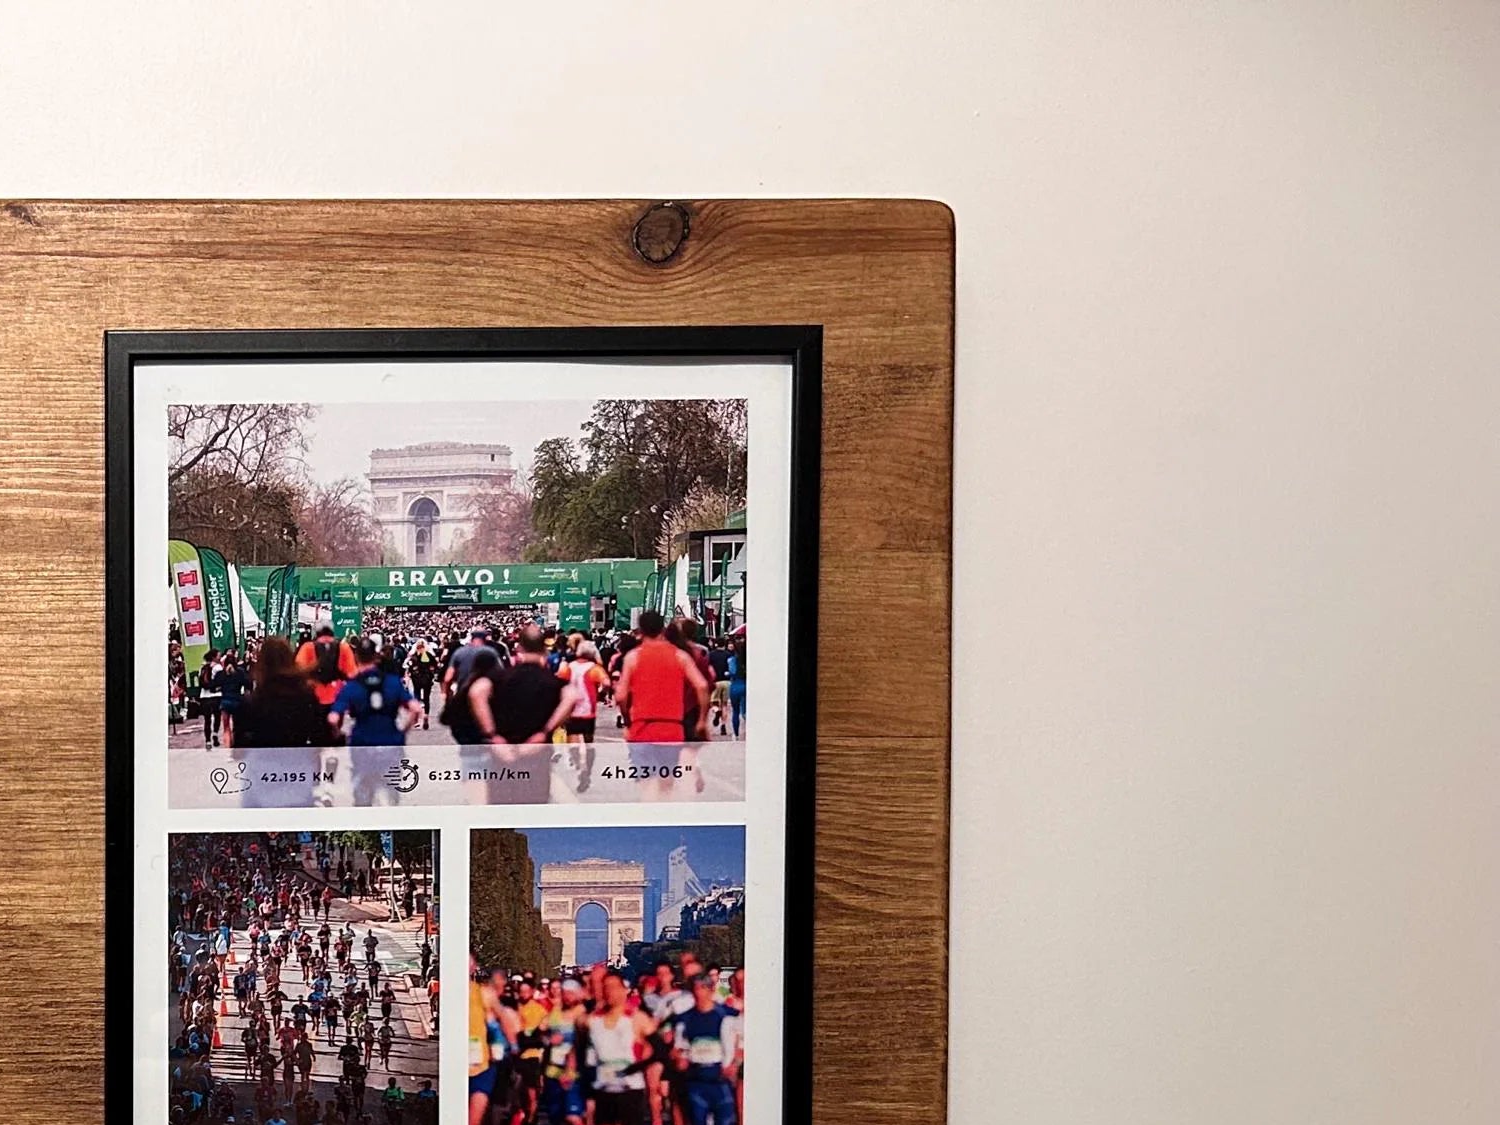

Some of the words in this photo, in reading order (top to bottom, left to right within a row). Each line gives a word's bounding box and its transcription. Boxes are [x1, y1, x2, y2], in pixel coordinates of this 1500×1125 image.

[207, 574, 224, 638] Schneider
[260, 772, 306, 783] 42.195
[312, 772, 335, 783] KM
[428, 770, 461, 782] 6:23
[468, 766, 531, 781] min/km
